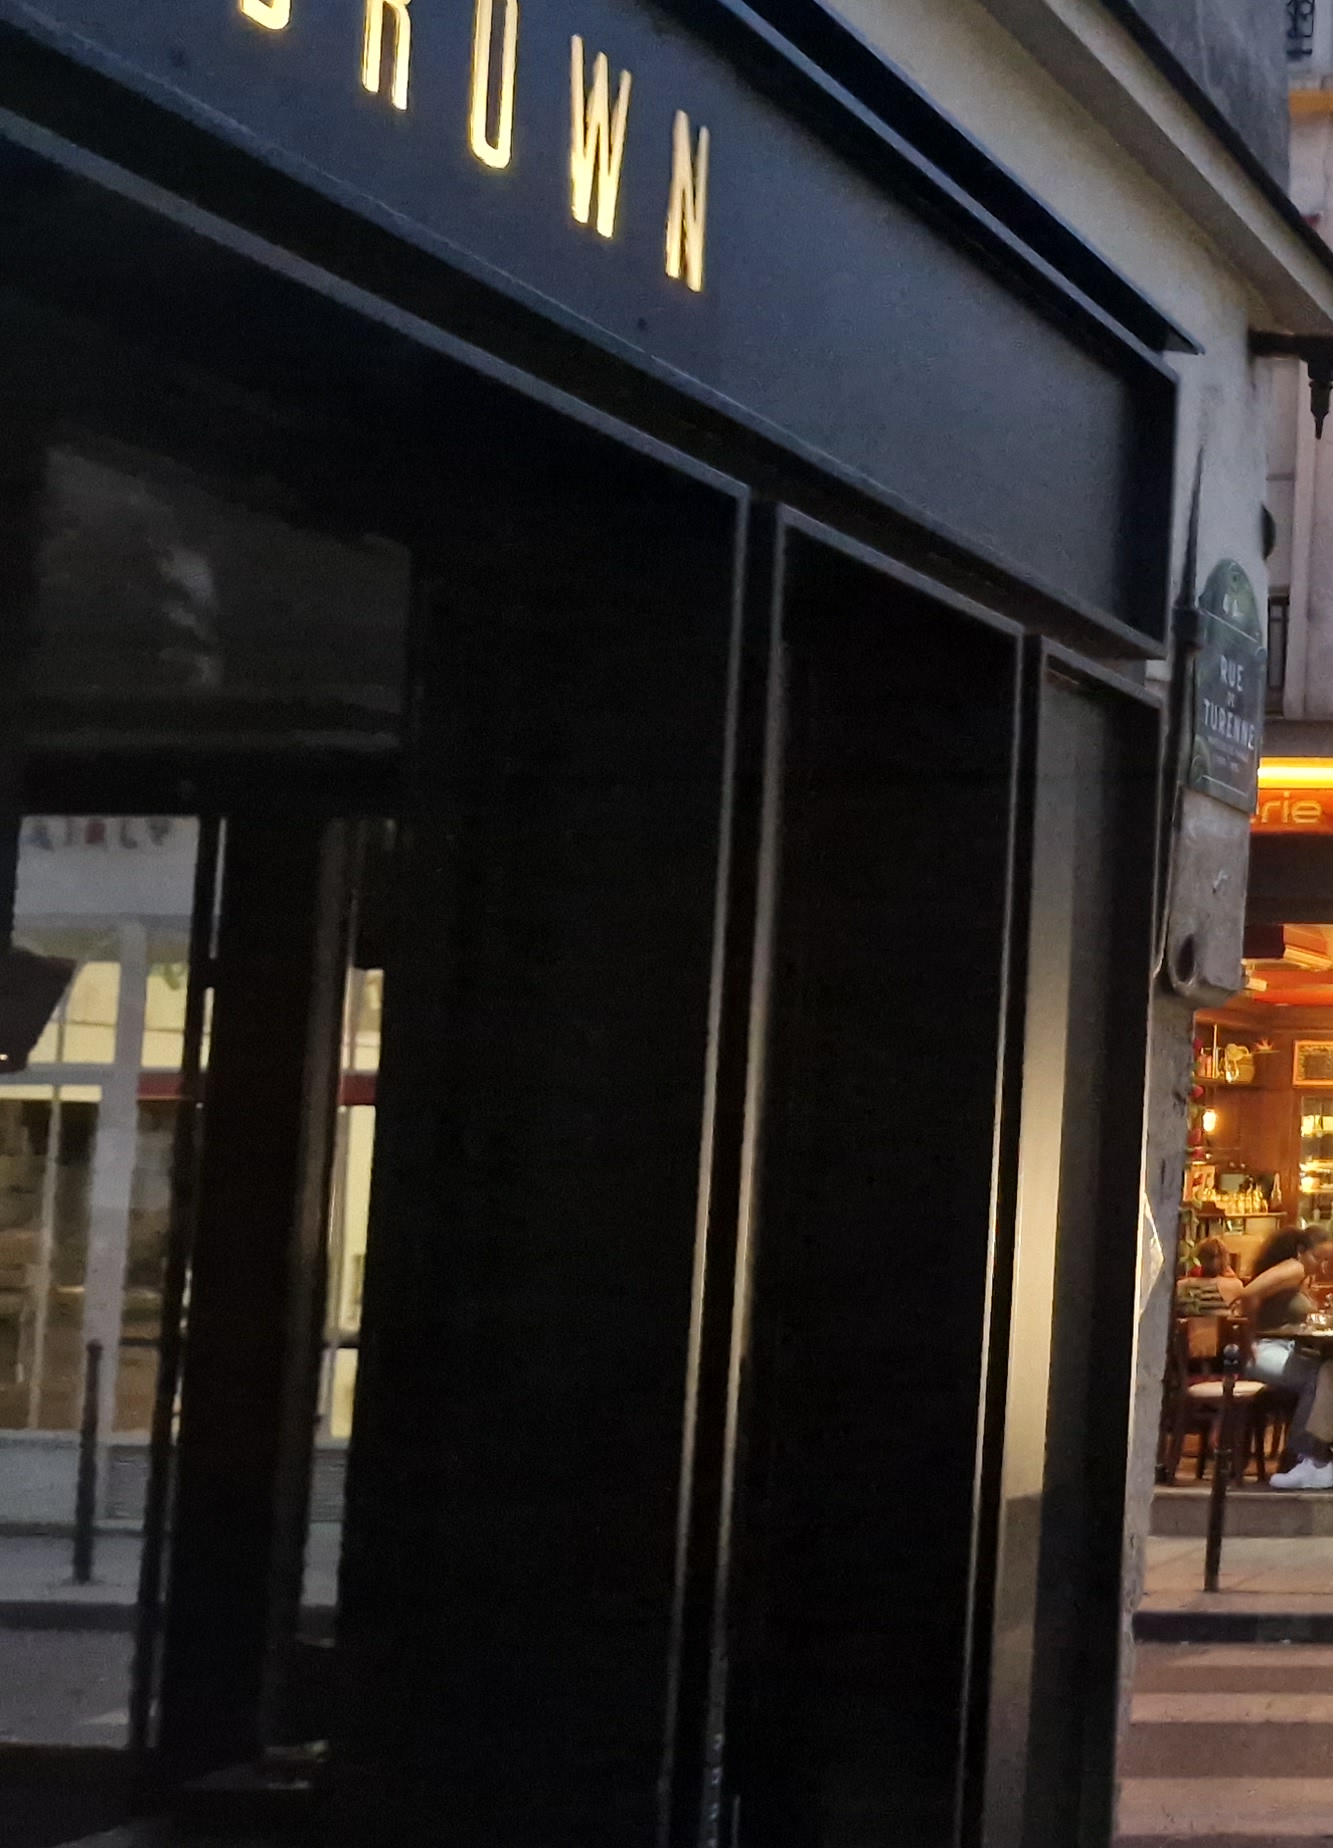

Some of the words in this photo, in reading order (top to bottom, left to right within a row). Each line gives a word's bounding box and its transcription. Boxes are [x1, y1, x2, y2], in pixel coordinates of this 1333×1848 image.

[1220, 654, 1244, 692] RUE
[1203, 698, 1256, 750] TURENNE
[1251, 790, 1322, 824] rie
